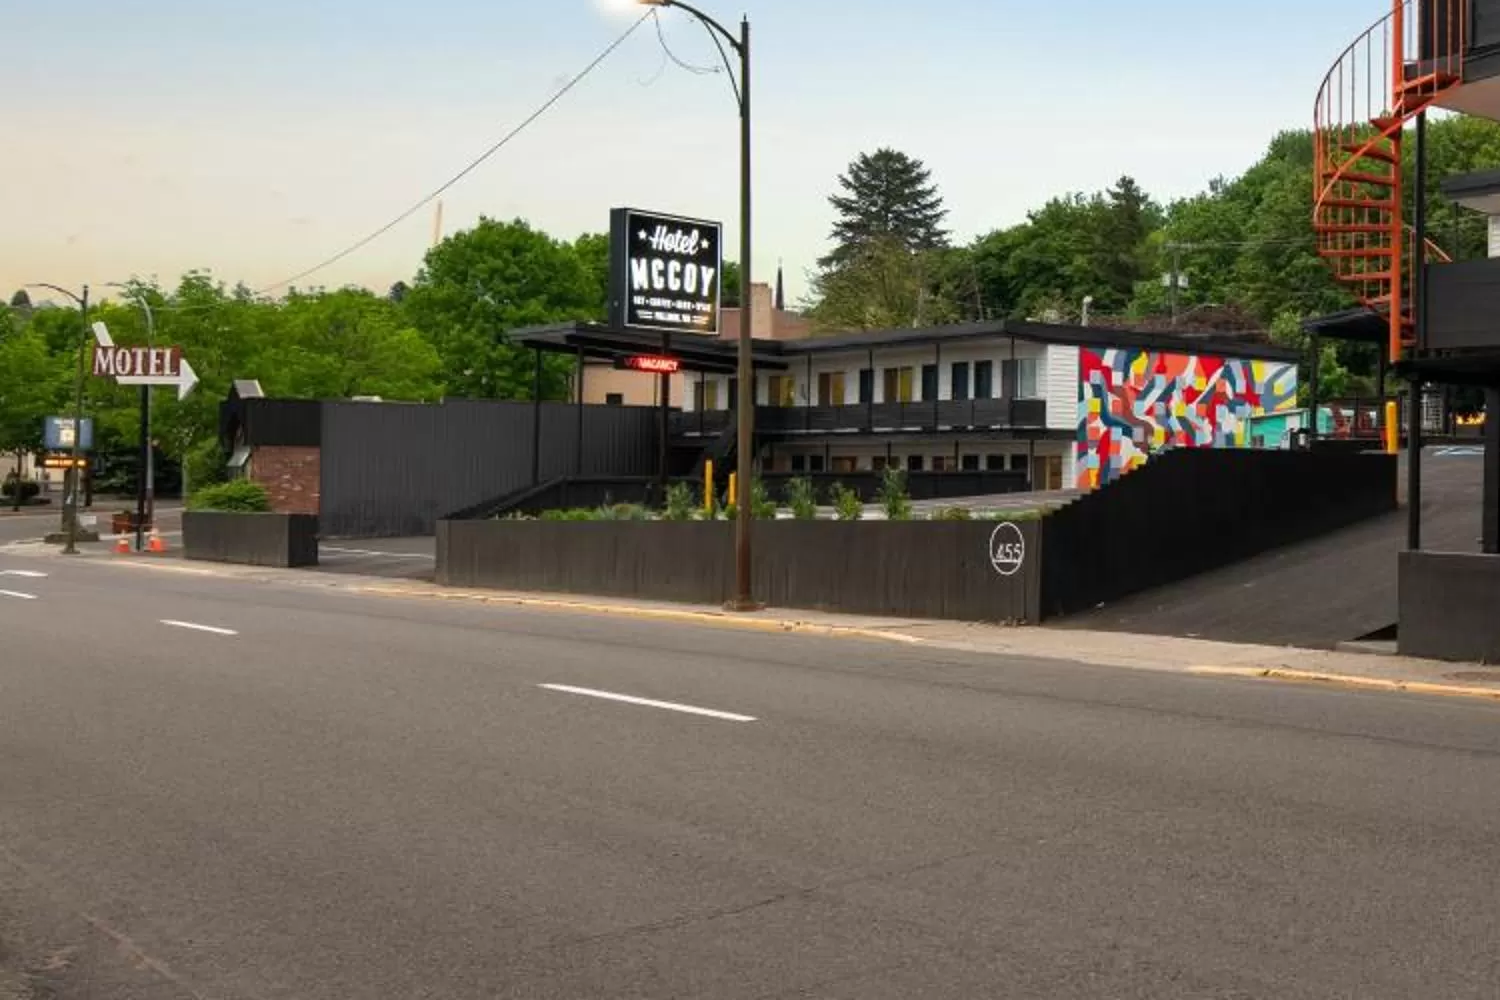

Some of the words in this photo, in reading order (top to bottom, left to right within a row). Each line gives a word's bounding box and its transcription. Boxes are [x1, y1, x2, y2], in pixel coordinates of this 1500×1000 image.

[648, 225, 700, 256] Hotel
[631, 258, 715, 297] MCCOY
[93, 347, 177, 375] MOTEL
[638, 357, 679, 371] VACANCY
[996, 543, 1021, 560] 455
